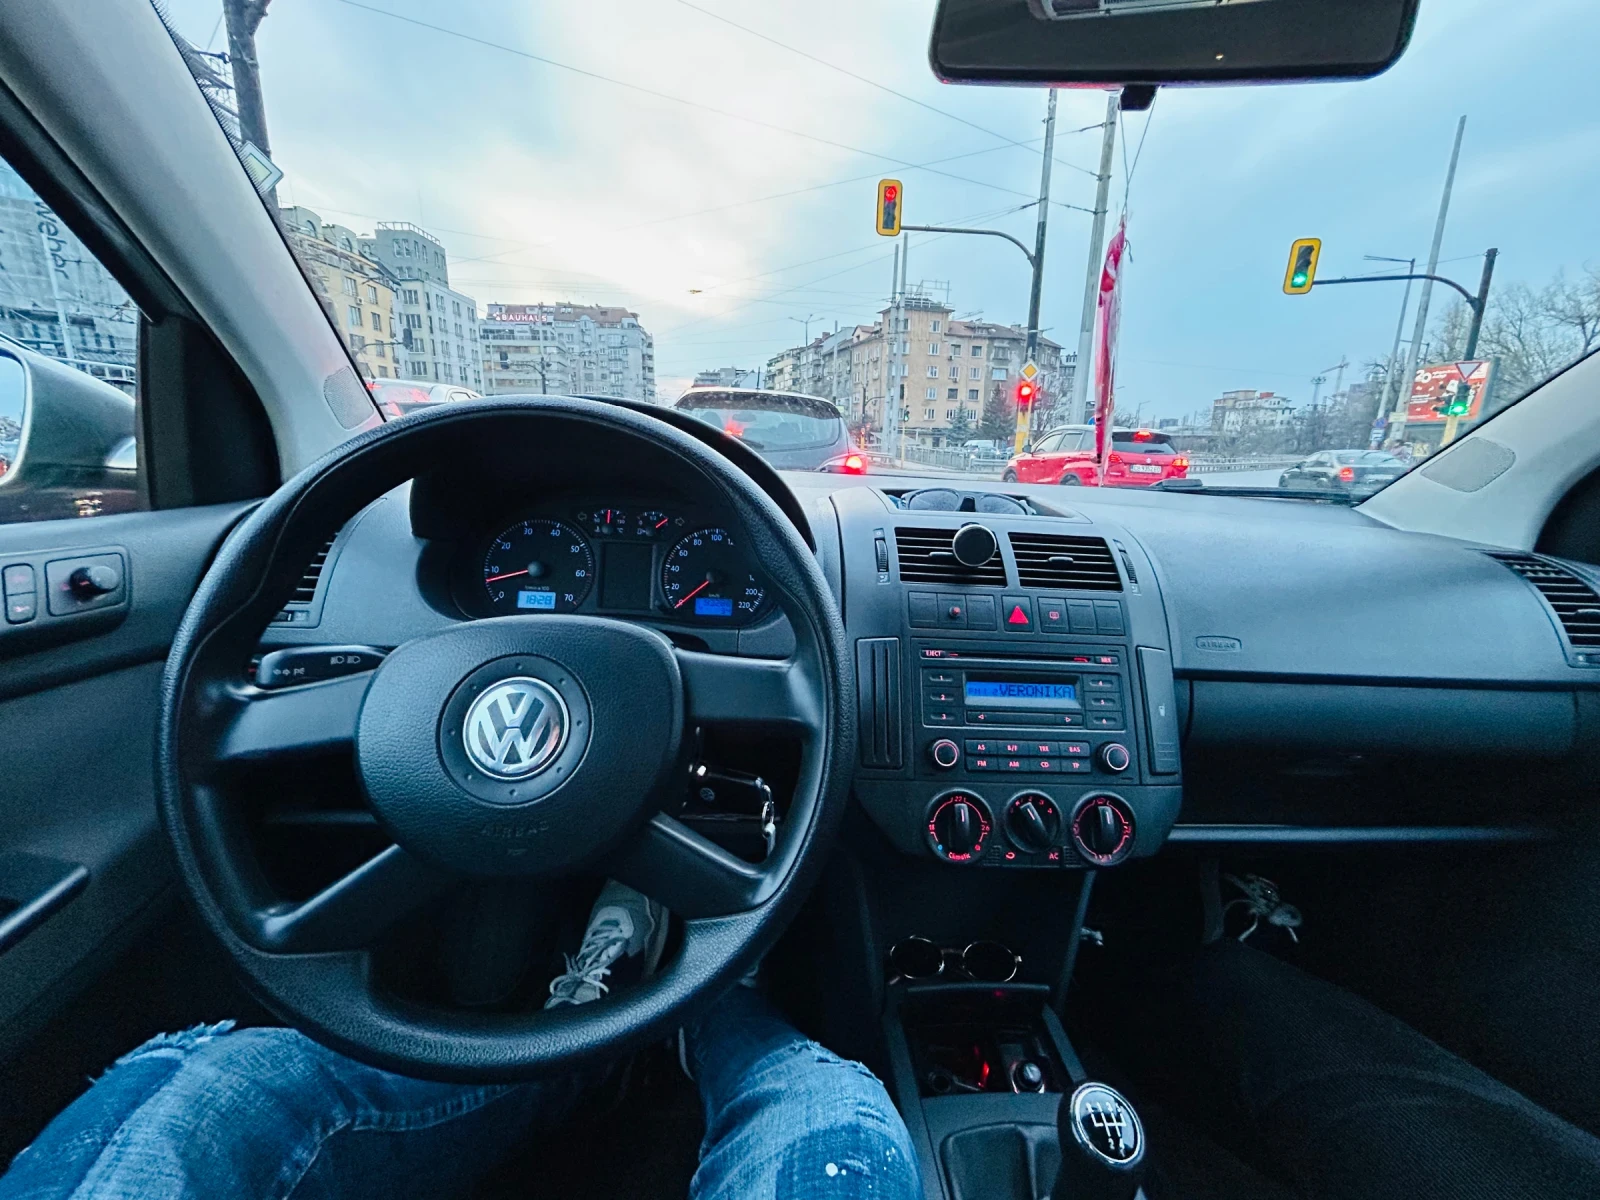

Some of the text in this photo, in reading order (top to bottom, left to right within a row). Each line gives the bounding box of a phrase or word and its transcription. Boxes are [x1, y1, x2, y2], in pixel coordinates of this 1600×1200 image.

[501, 313, 547, 322] BAUHAUS
[501, 541, 511, 550] 20
[693, 538, 702, 546] 80
[570, 545, 580, 553] 50
[679, 549, 688, 557] 60
[575, 569, 586, 577] 60
[564, 594, 573, 602] 70
[738, 601, 750, 609] 220
[925, 649, 941, 657] EJECT
[1000, 683, 1072, 699] VERONIKA
[1049, 852, 1059, 860] AC
[1108, 1138, 1115, 1150] 2
